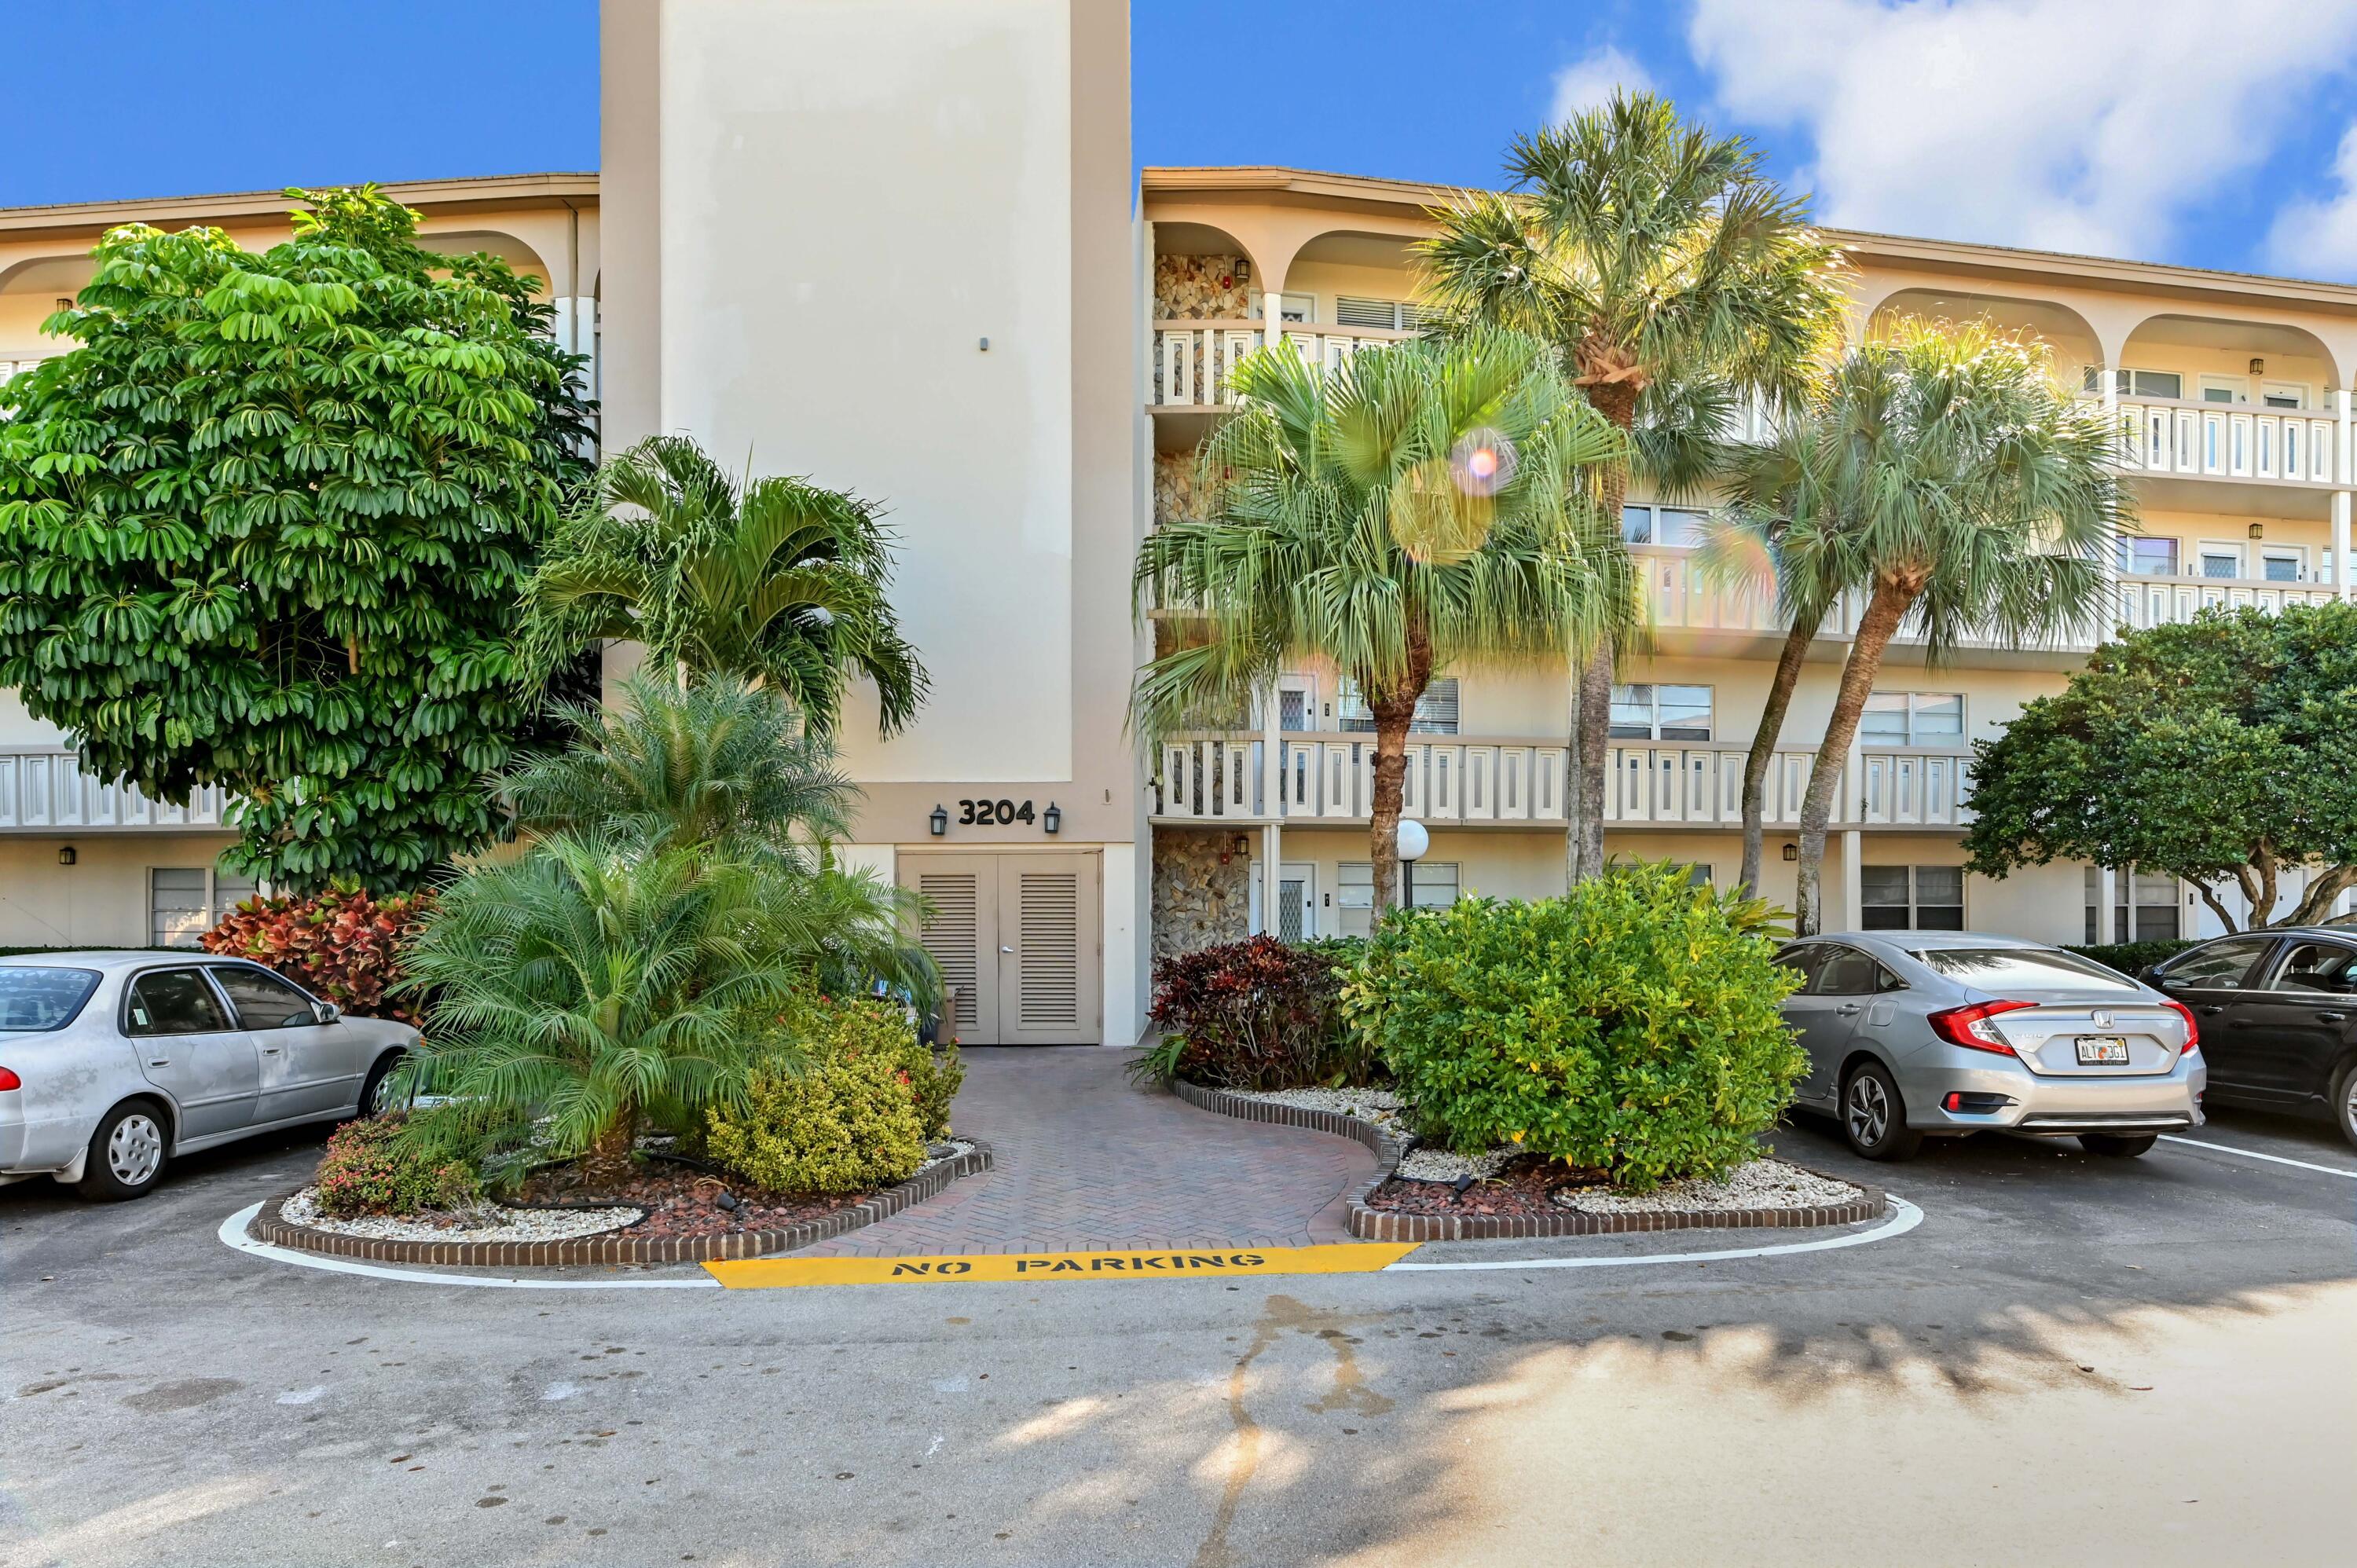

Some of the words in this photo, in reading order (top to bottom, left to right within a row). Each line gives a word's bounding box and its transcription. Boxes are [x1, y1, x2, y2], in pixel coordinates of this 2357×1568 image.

[959, 799, 1036, 825] 3204
[892, 1262, 971, 1276] NO
[1017, 1255, 1265, 1273] PARKING
